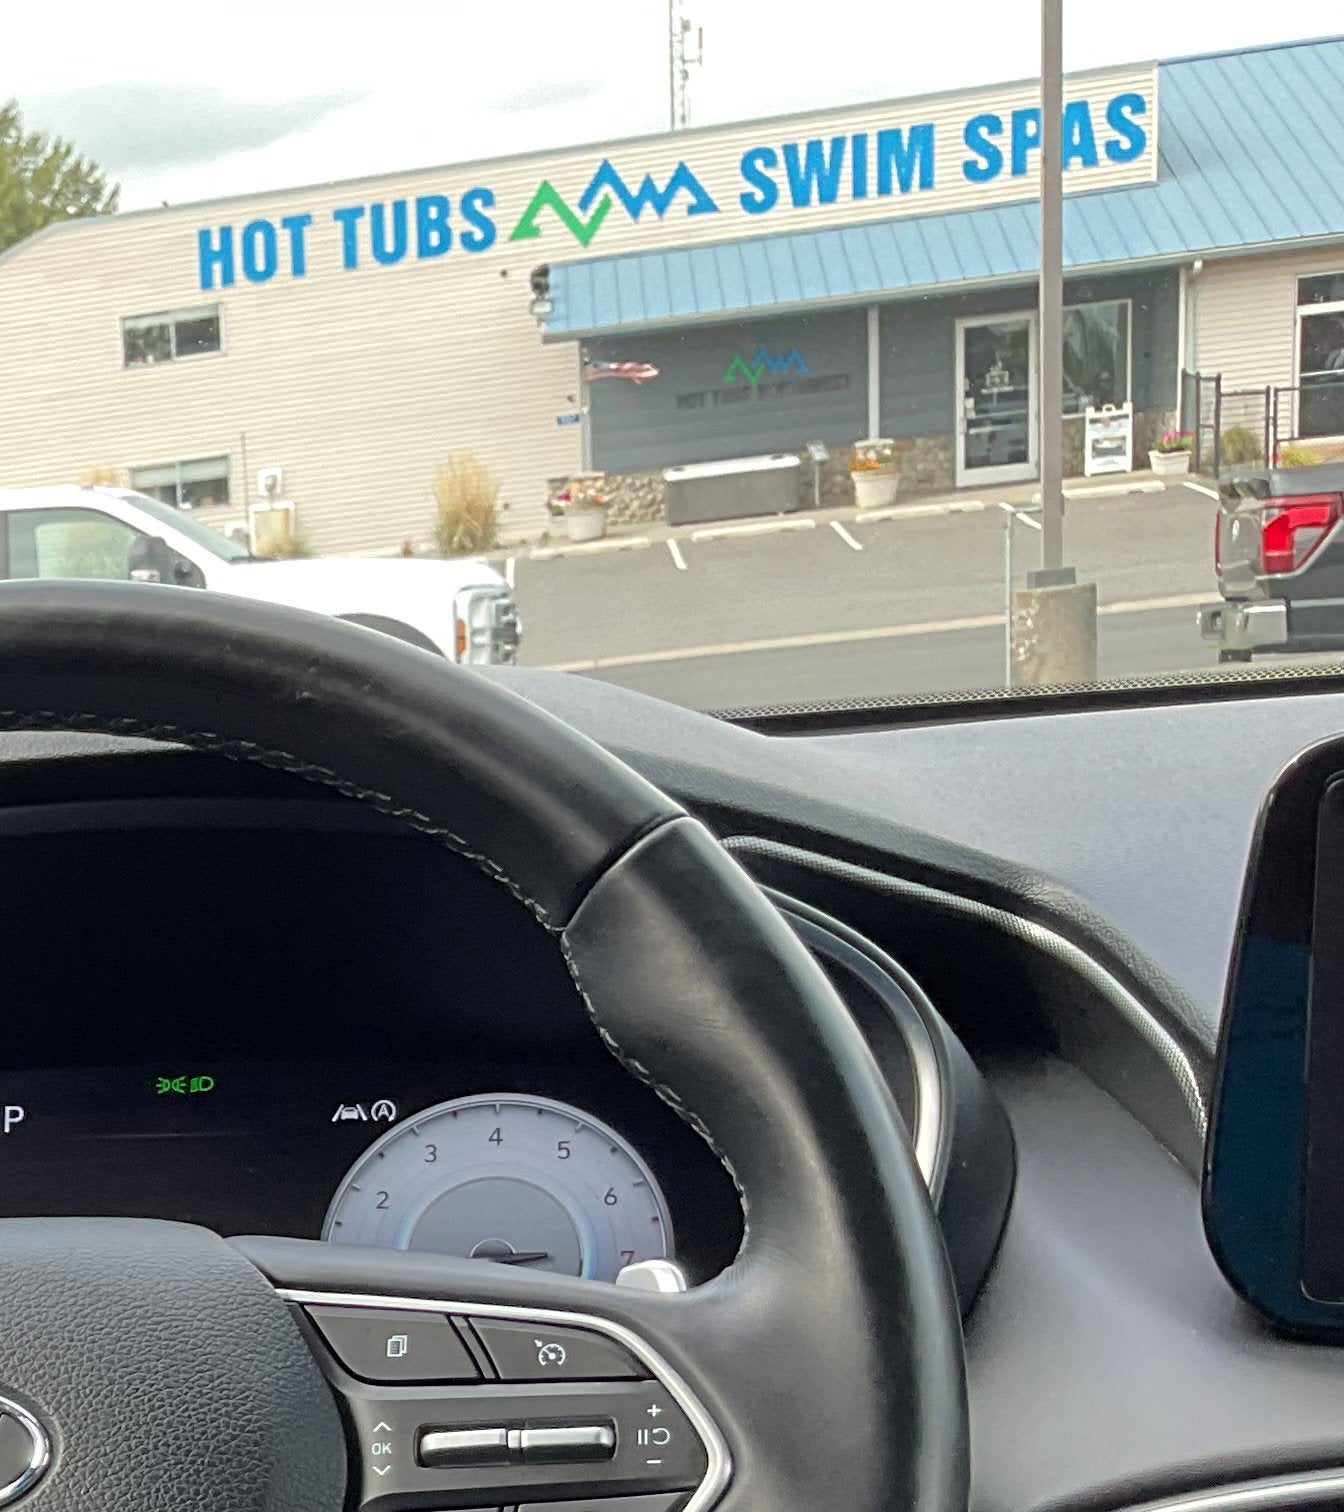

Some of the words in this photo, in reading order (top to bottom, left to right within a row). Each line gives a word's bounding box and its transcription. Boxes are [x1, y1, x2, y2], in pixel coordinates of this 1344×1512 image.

[198, 213, 313, 290] HOT
[333, 187, 497, 270] TUBS
[739, 122, 936, 214] SWIM
[962, 93, 1148, 184] SPAS
[2, 1105, 25, 1133] P
[488, 1127, 503, 1146] 4
[423, 1144, 437, 1163] 3
[557, 1140, 571, 1160] 5
[375, 1191, 390, 1210] 2
[604, 1187, 618, 1206] 6
[371, 1443, 392, 1455] OK
